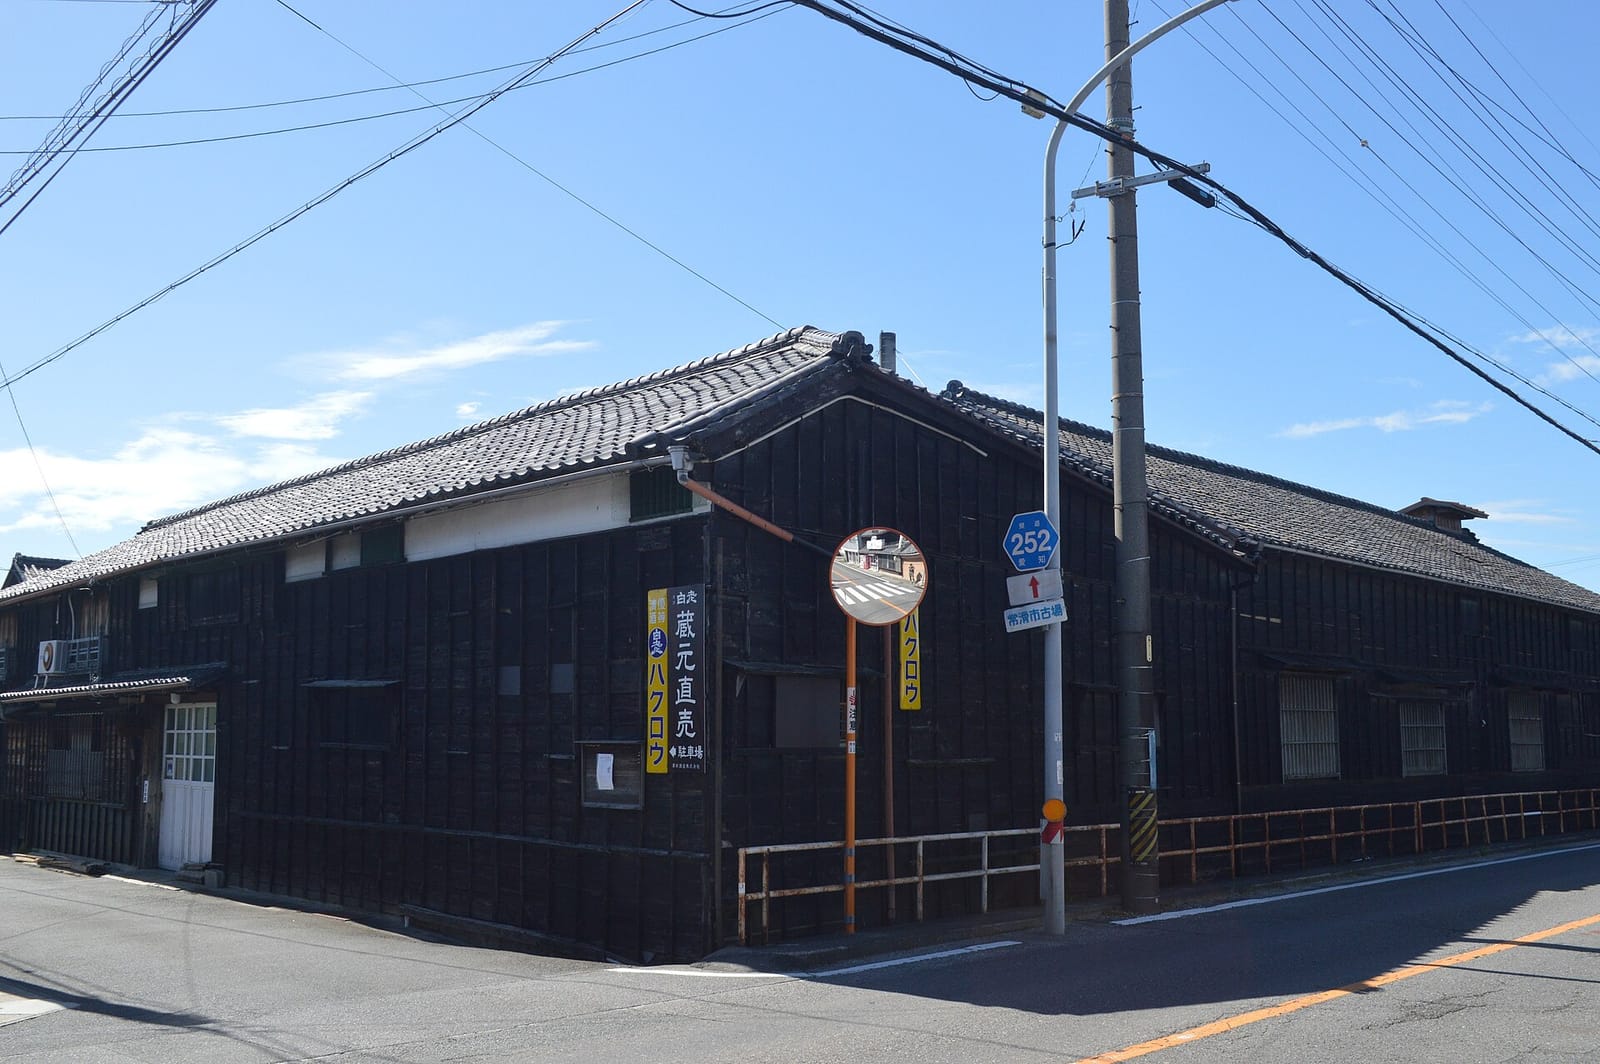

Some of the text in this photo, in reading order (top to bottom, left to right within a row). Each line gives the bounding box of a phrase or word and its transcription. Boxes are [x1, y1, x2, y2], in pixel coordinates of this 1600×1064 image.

[1011, 528, 1052, 556] 252
[1007, 602, 1063, 627] 常滑市古場
[675, 609, 697, 739] 蔵元直売
[649, 663, 666, 766] ハクロウ
[677, 744, 704, 760] 駐車場
